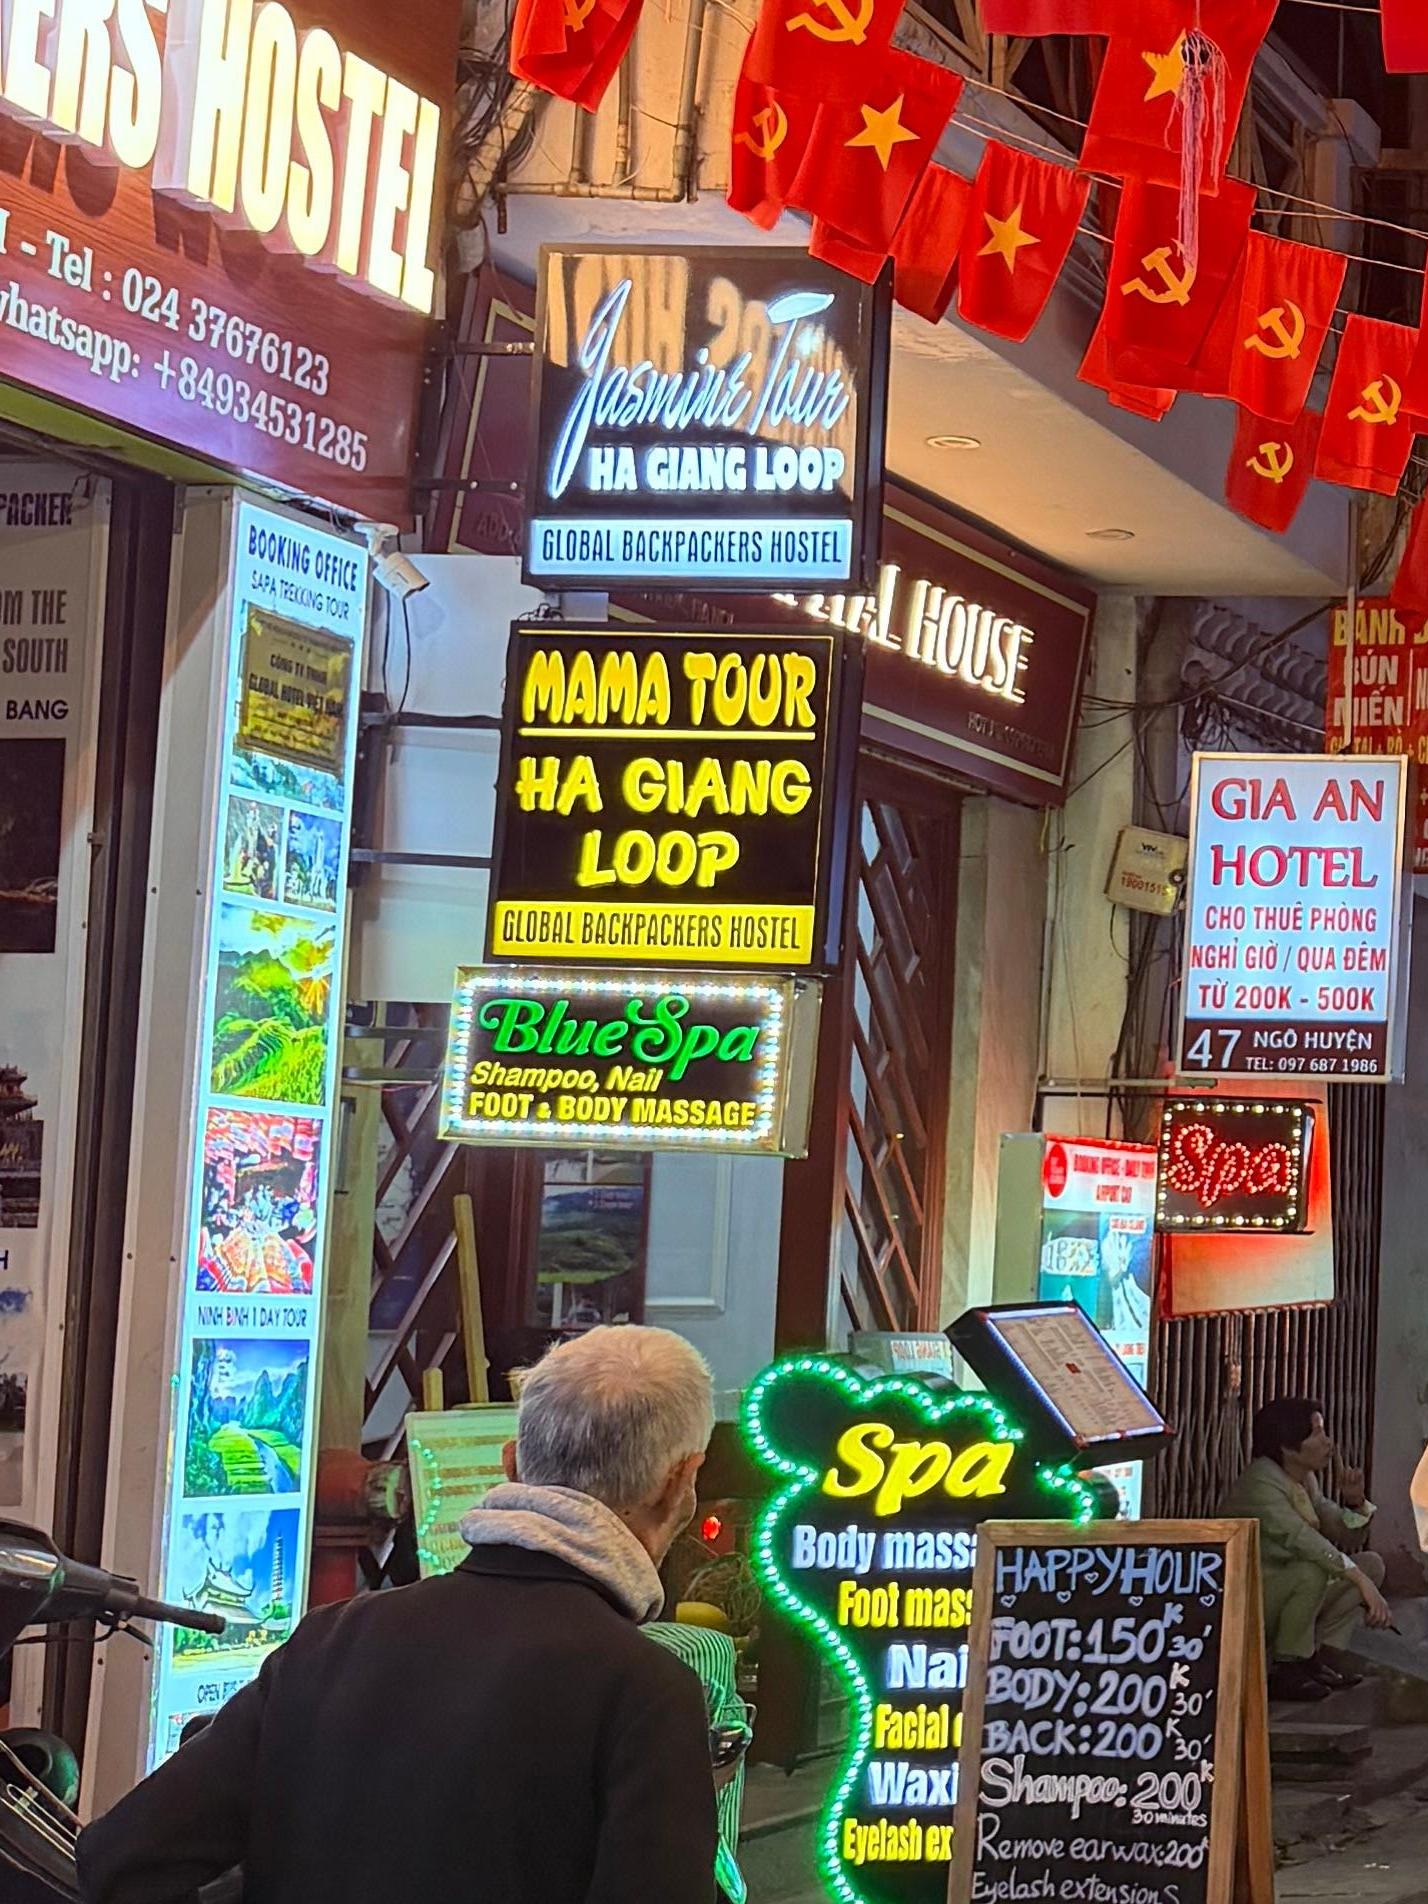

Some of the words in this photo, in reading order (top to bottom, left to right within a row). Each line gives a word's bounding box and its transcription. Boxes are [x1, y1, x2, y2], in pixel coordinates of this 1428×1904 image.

[46, 230, 93, 293] Tel
[122, 267, 180, 331] 024
[188, 298, 331, 396] 37676123
[154, 350, 369, 473] +84934531285
[547, 278, 752, 500] Jasmine
[749, 291, 850, 435] Tour
[589, 447, 638, 491] HA
[647, 446, 747, 491] GIANG
[754, 446, 845, 491] LOOP
[249, 525, 310, 573] BOOKING
[315, 550, 358, 591] OFFICE
[542, 529, 615, 562] GLOBAL
[622, 529, 763, 564] BACKPACKERS
[770, 530, 842, 564] HOSTEL
[31, 590, 67, 625] THE
[251, 570, 276, 595] SAPA
[279, 579, 323, 612] TREKKING
[326, 595, 349, 620] TOUR
[2, 638, 69, 673] SOUTH
[908, 579, 1034, 704] HOUSE
[6, 700, 69, 720] BANG
[525, 650, 671, 726] MAMA
[684, 651, 816, 728] TOUR
[516, 755, 603, 817] HA
[622, 757, 812, 818] GIANG
[1211, 778, 1296, 821] GIA
[1313, 779, 1384, 821] AN
[577, 830, 740, 889] LOOP
[1210, 845, 1378, 888] HOTEL
[502, 910, 574, 944] GLOBAL
[581, 912, 722, 947] BACKPACKERS
[729, 916, 801, 950] HOSTEL
[1205, 906, 1245, 930] CHO
[1253, 901, 1302, 931] THUÊ
[1311, 902, 1376, 932] PHÒNG
[1191, 937, 1237, 969] NGHỈ
[1245, 939, 1278, 970] GIỜ
[1298, 947, 1336, 972] QUA
[1344, 941, 1386, 971] ĐÊM
[1199, 978, 1228, 1009] TỪ
[1235, 986, 1291, 1009] 200K
[1318, 987, 1374, 1011] 500K
[478, 998, 630, 1056] Blue
[624, 995, 760, 1081] Spa
[1187, 1029, 1242, 1069] 47
[1253, 1029, 1297, 1049] NGÔ
[1304, 1031, 1372, 1054] HUYỆN
[470, 1061, 600, 1093] Shampoo,
[605, 1065, 664, 1093] Nail
[1245, 1057, 1274, 1071] TEL:
[1278, 1058, 1304, 1072] 097
[1310, 1058, 1336, 1072] 687
[1342, 1059, 1378, 1074] 1986
[469, 1092, 534, 1119] FOOT
[558, 1097, 628, 1123] BODY
[631, 1098, 756, 1127] MASSAGE
[1167, 1123, 1293, 1207] Spa
[260, 1307, 280, 1327] DAY
[283, 1308, 307, 1327] TOUR
[823, 1422, 1015, 1517] Spa
[793, 1525, 876, 1576] Body
[996, 1548, 1123, 1595] HAPPY
[1120, 1548, 1220, 1595] HOUR
[839, 1580, 899, 1628] Foot
[875, 1703, 948, 1751] Facial
[978, 1754, 1127, 1819] Shampoo:
[842, 1818, 922, 1865] Eyelash
[977, 1812, 1064, 1862] Remove
